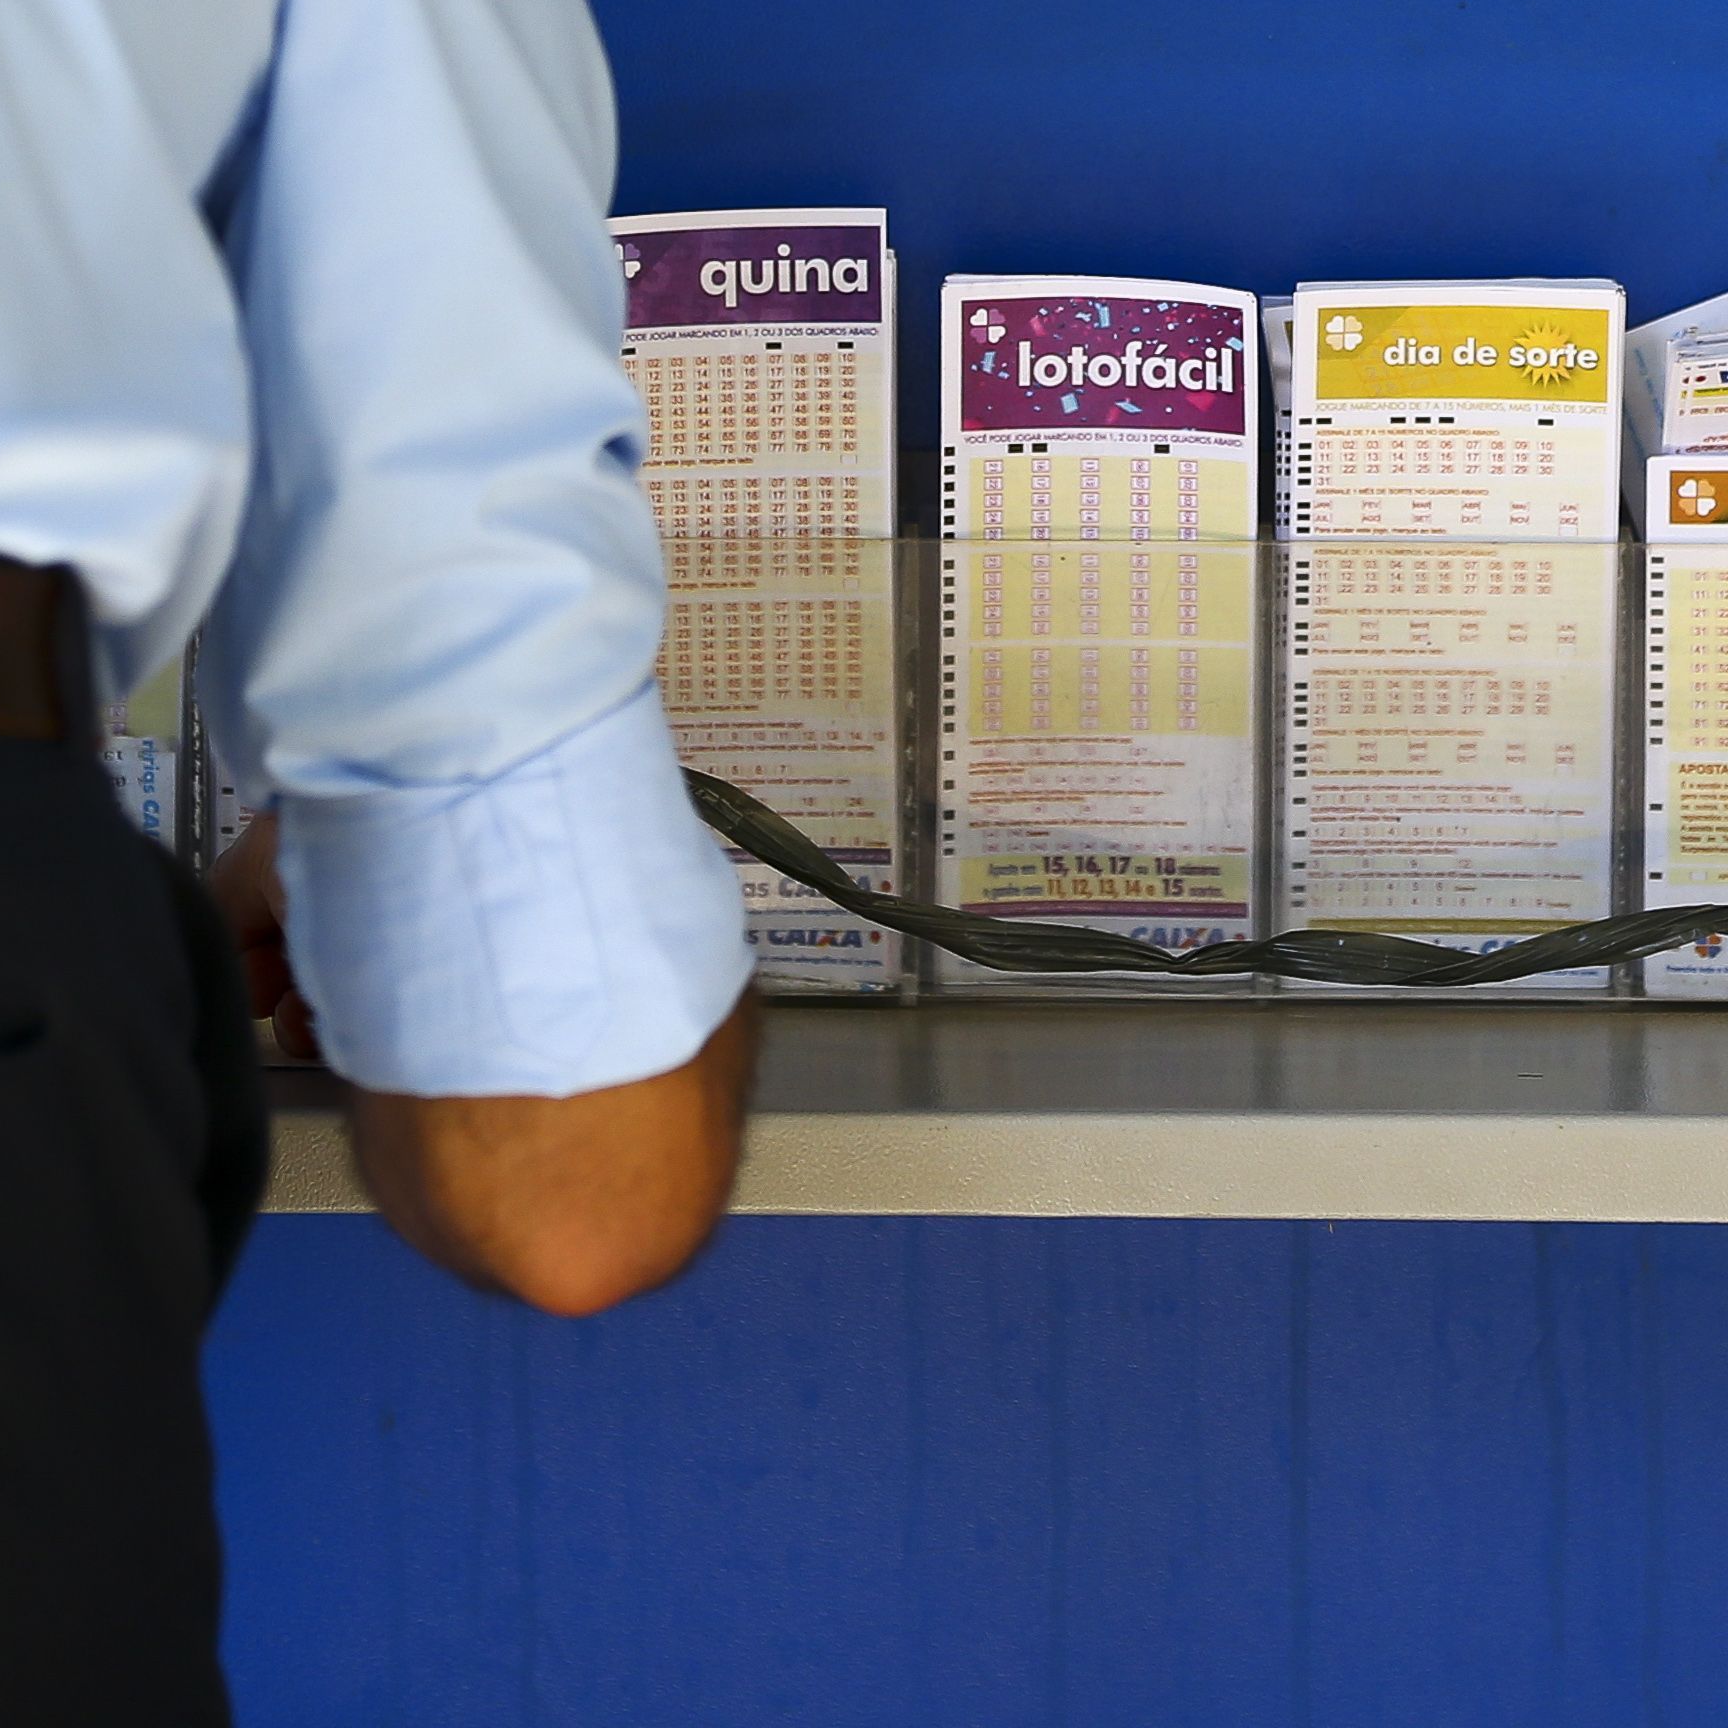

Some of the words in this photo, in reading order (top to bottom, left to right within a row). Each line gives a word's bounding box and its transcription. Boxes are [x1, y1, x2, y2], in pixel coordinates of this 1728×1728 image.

[700, 244, 868, 308] quina
[1383, 338, 1441, 366] dia
[1453, 338, 1498, 366] de
[1509, 344, 1599, 369] sorte
[1018, 341, 1234, 393] lotofácil
[1679, 764, 1728, 776] APOSTA
[1042, 856, 1069, 876] 15,
[1075, 856, 1102, 877] 16,
[1108, 857, 1131, 874] 17
[1155, 857, 1176, 875] 18
[1163, 879, 1184, 896] 15
[768, 930, 862, 947] CAIXA
